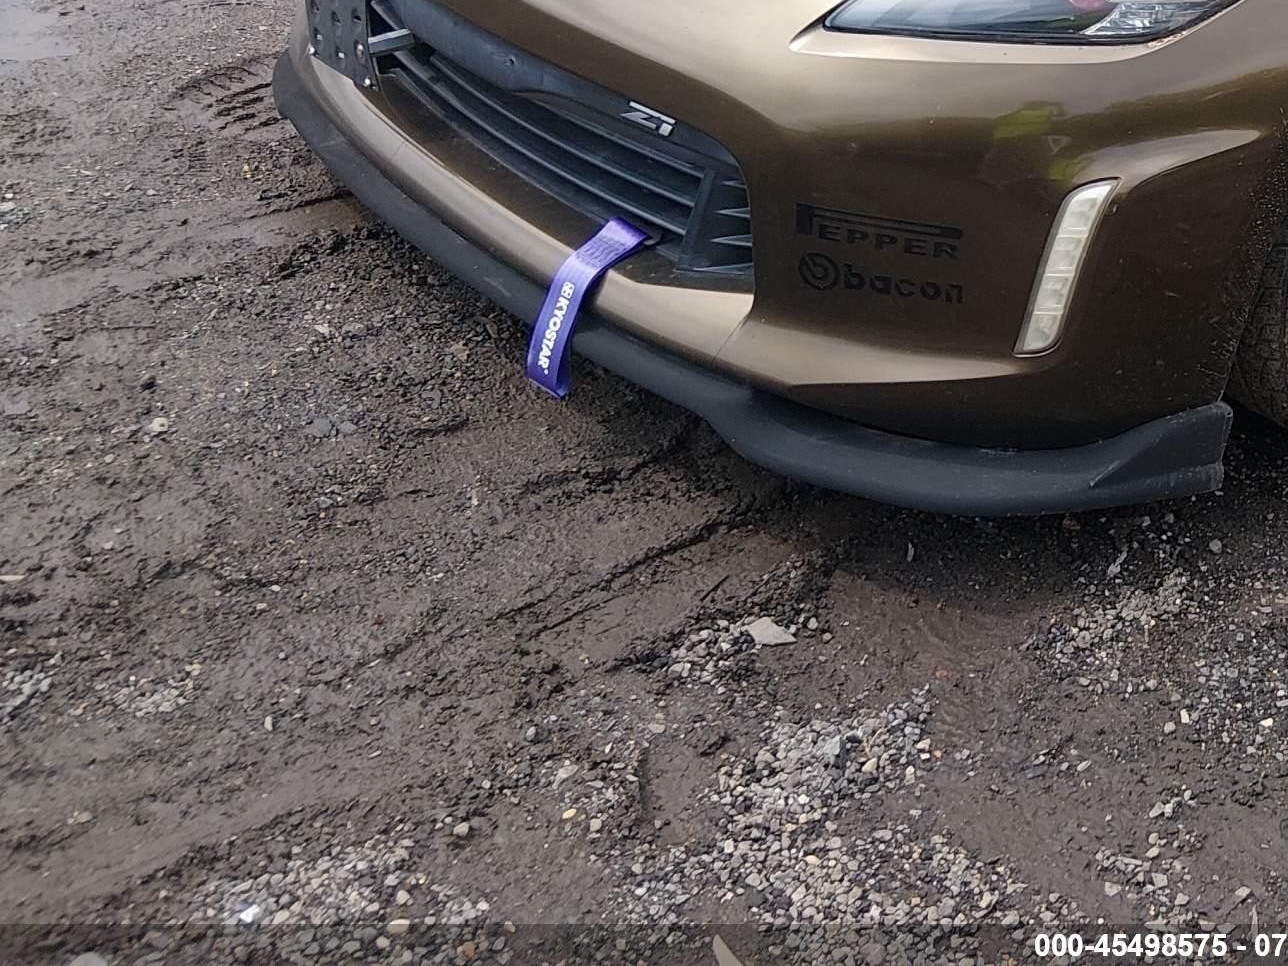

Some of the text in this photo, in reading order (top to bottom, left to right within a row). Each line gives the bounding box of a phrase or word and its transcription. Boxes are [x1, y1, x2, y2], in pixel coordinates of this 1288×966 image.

[796, 202, 967, 261] PEPPER
[843, 263, 964, 304] bacon
[537, 297, 570, 369] KYOSTAR
